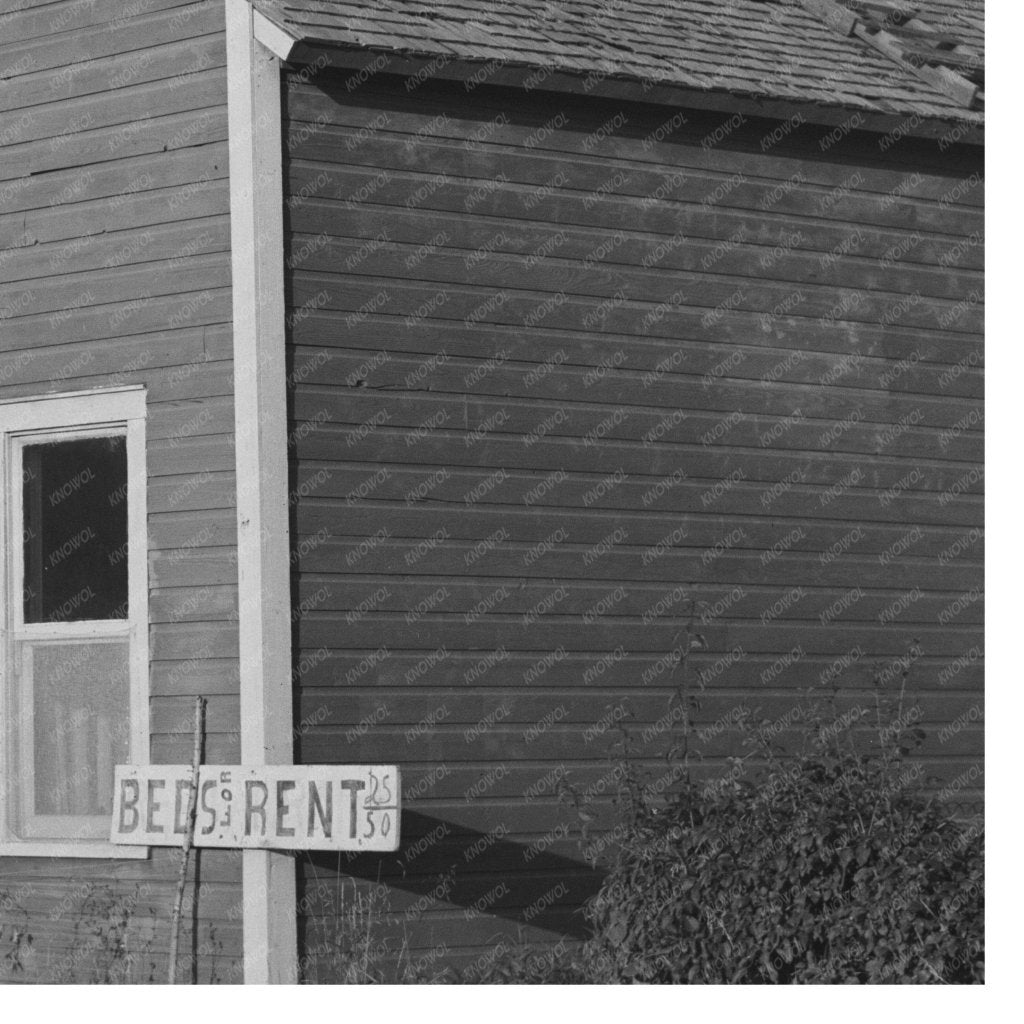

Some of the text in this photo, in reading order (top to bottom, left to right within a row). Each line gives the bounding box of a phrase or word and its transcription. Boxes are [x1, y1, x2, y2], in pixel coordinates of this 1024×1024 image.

[364, 771, 392, 806] 25
[244, 779, 366, 839] RENT
[362, 811, 391, 838] 50
